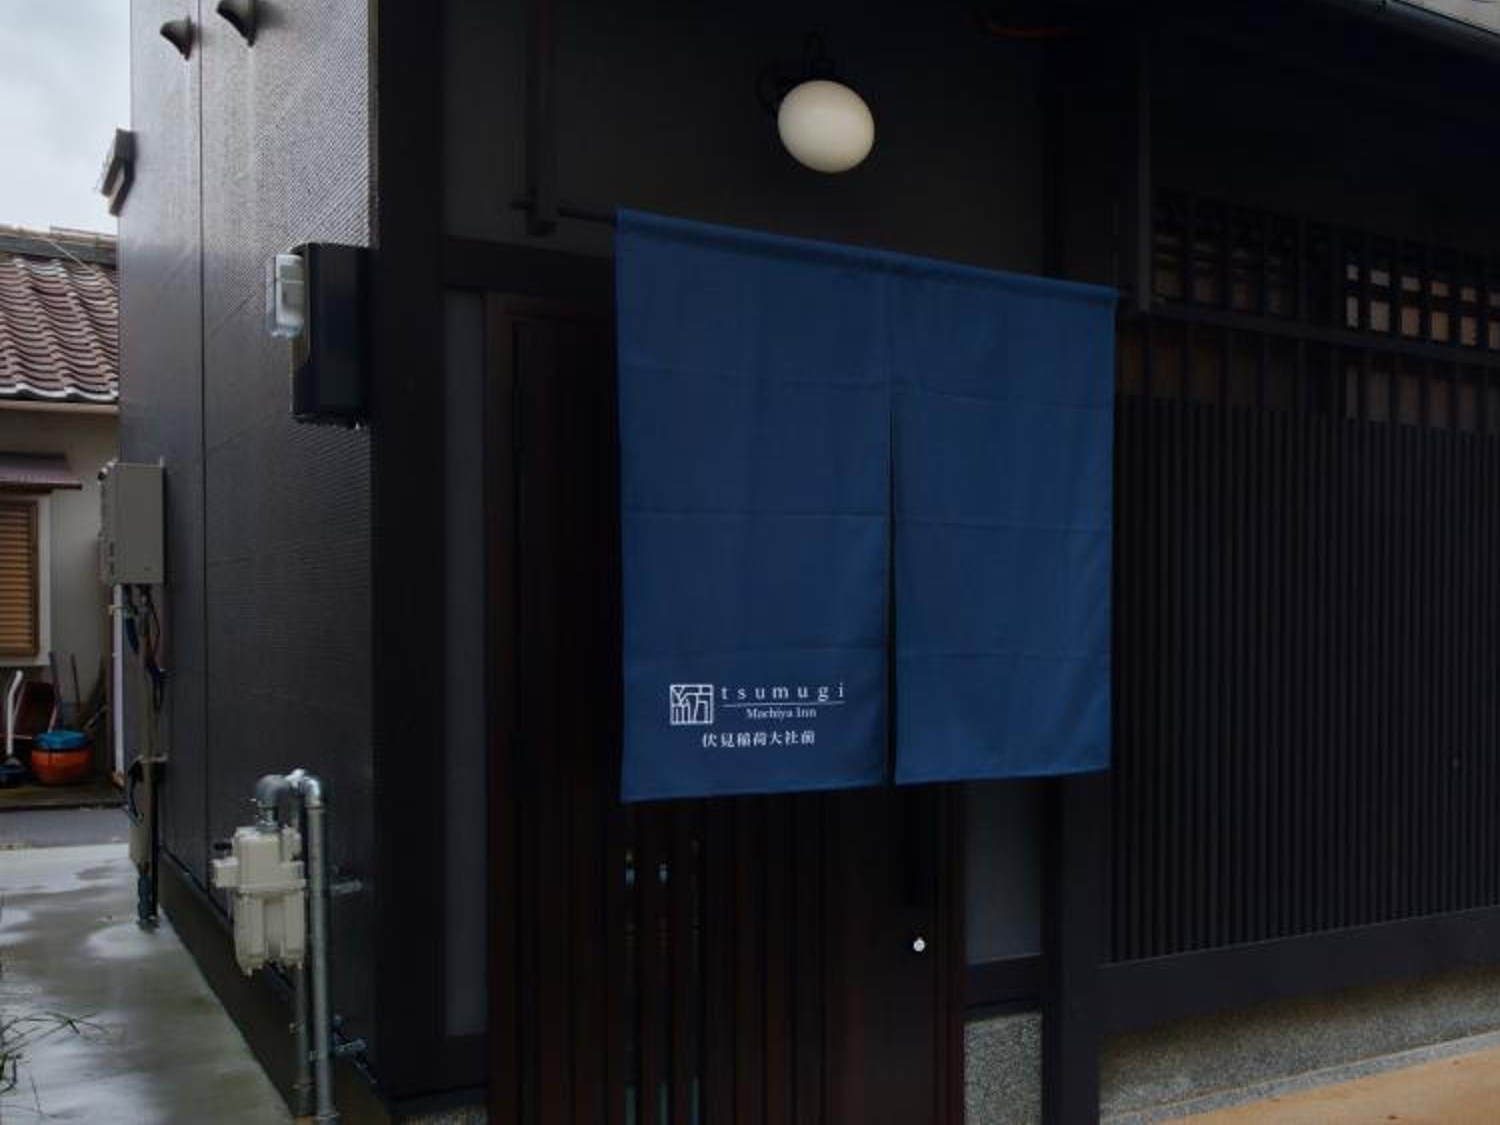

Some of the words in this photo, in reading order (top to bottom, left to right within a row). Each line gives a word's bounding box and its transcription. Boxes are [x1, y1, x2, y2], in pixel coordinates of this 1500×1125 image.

[721, 682, 845, 702] tsumugi
[746, 707, 793, 721] Machiya
[796, 707, 817, 719] Inn
